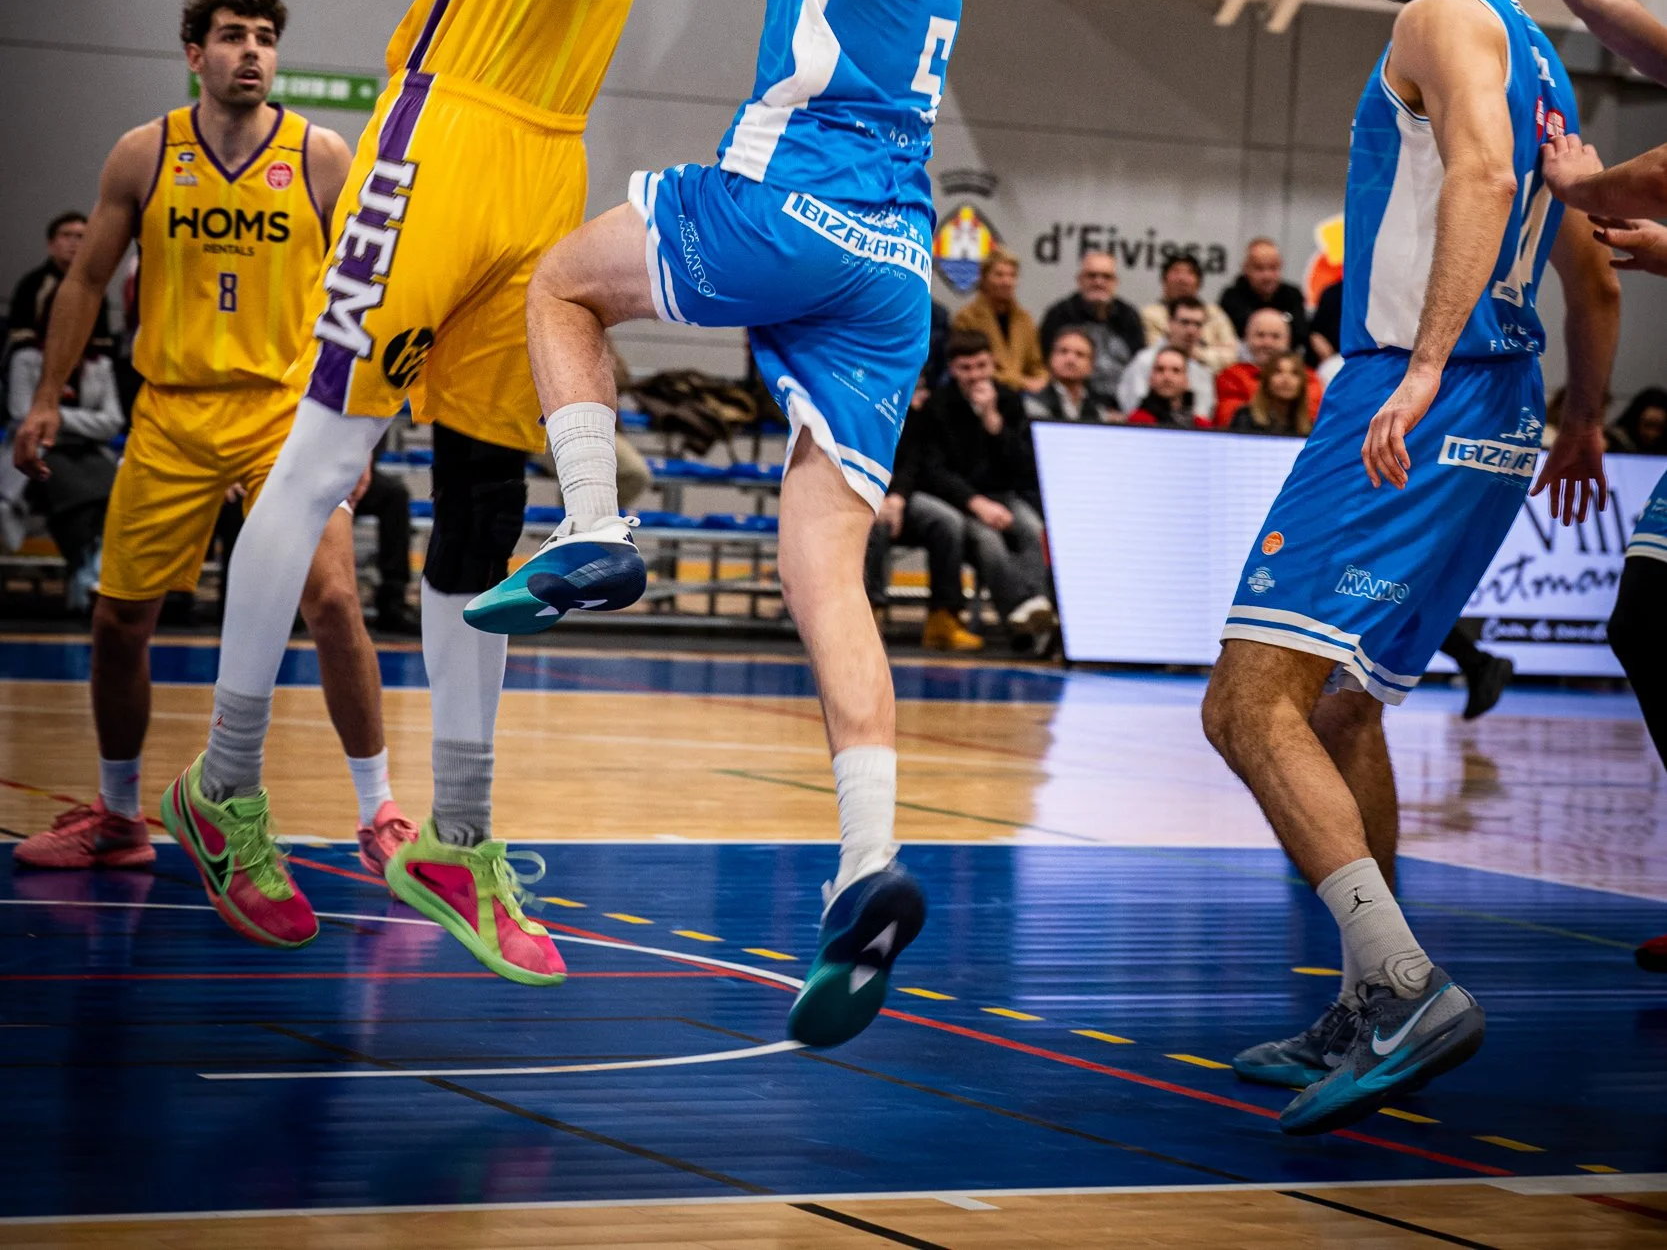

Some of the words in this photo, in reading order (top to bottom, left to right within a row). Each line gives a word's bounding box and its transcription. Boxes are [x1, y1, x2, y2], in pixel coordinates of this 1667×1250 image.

[168, 207, 290, 243] HOMS
[203, 243, 255, 257] RENTALS
[218, 272, 238, 313] 8
[1334, 571, 1410, 605] MAMO
